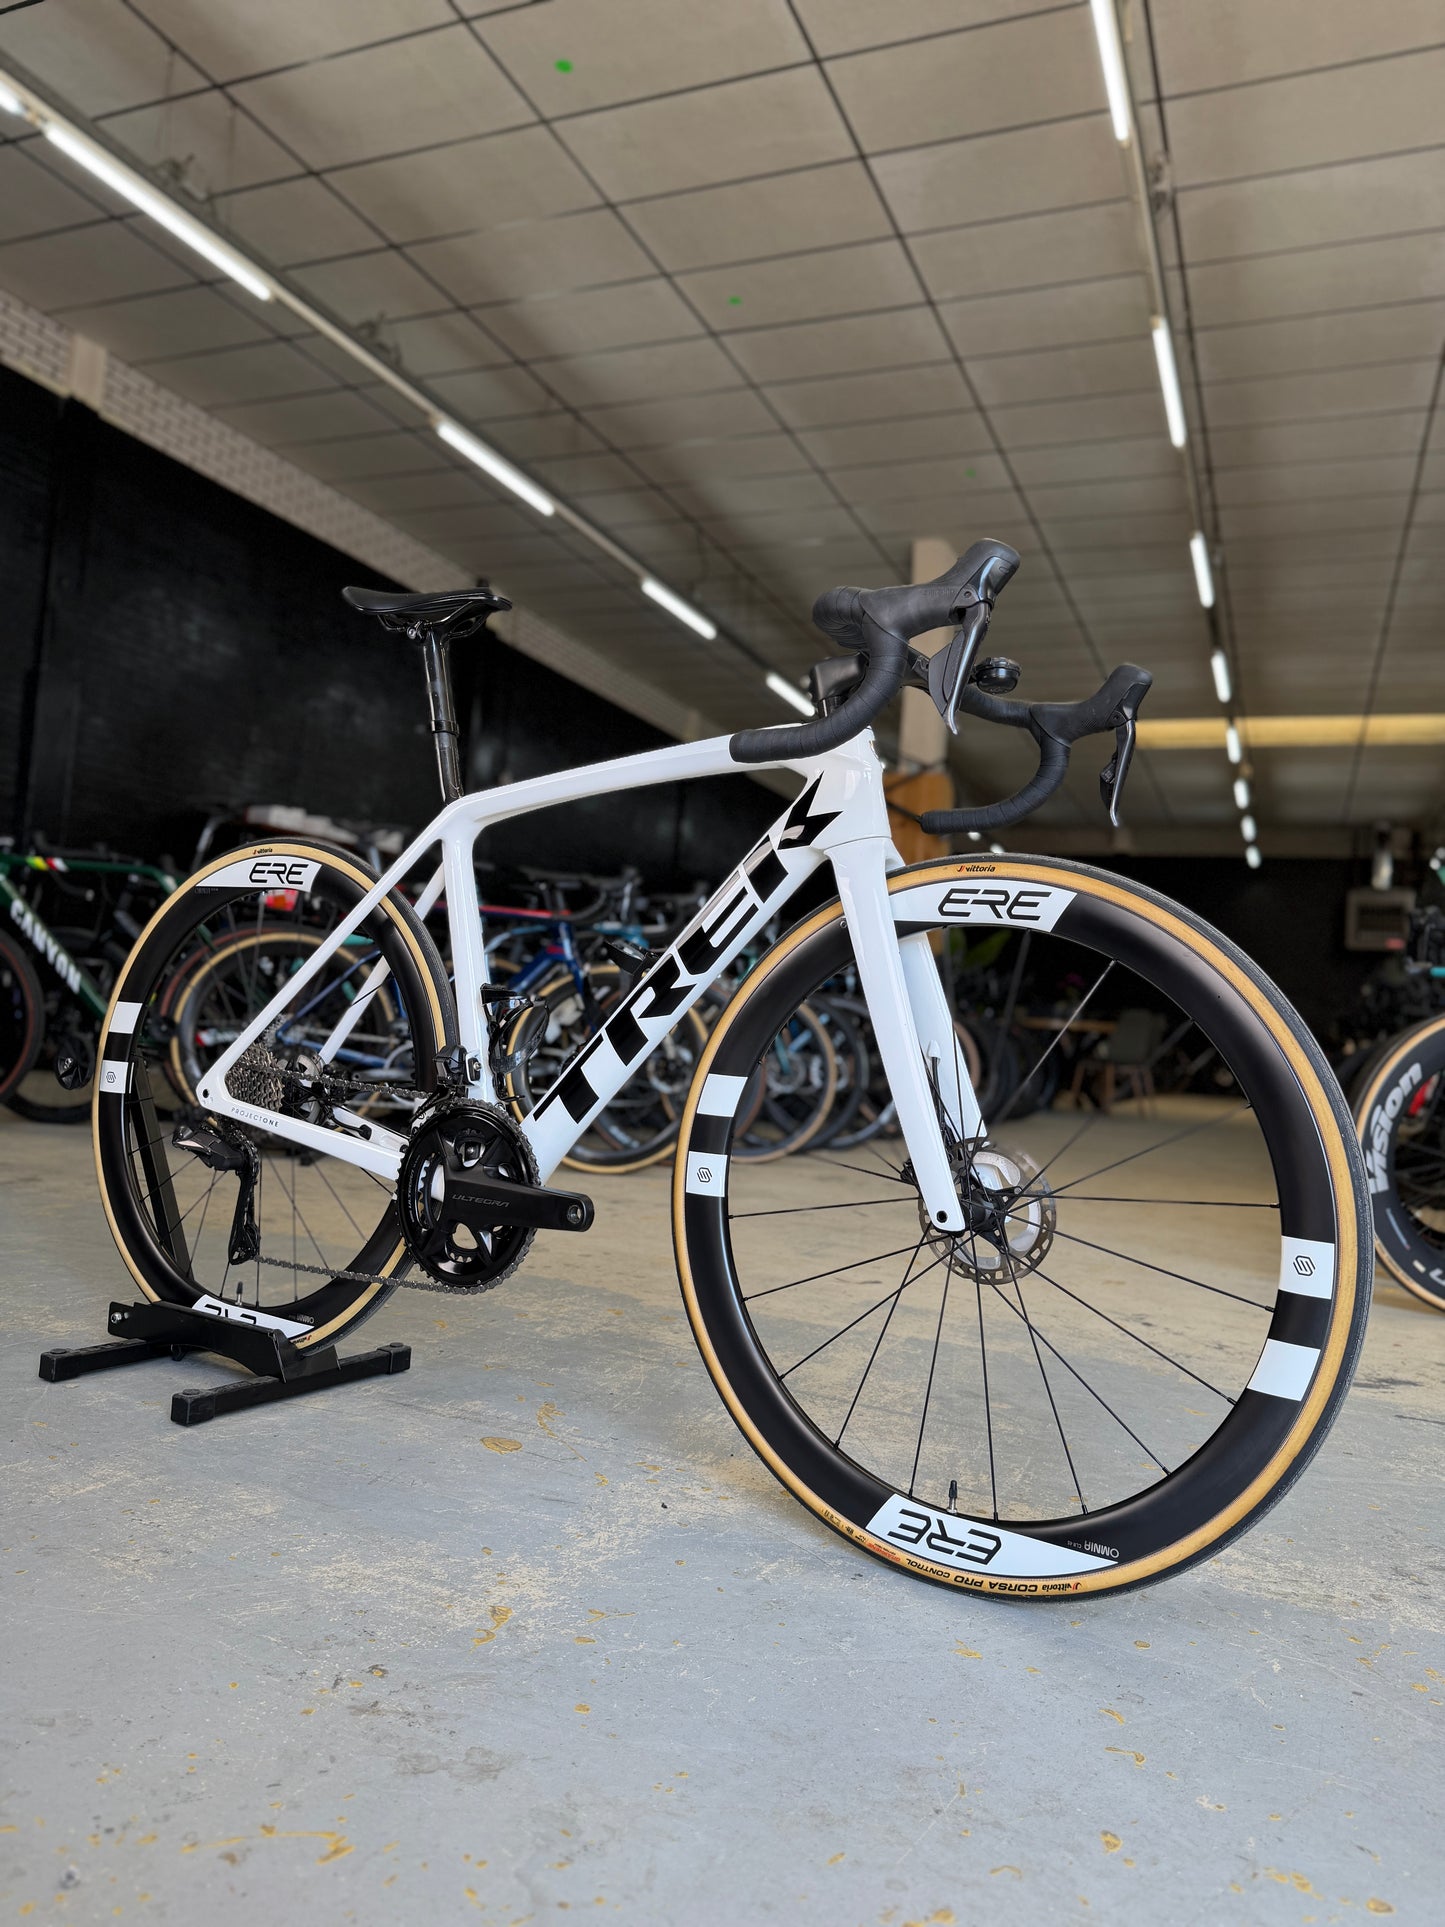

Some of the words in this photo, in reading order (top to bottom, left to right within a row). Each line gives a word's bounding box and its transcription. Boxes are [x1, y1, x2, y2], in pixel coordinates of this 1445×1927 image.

[249, 862, 309, 885] ERE
[965, 865, 996, 873] vittoria
[938, 888, 1052, 921] ERE
[10, 899, 82, 995] CANYON
[533, 770, 844, 1124] TREK
[452, 1194, 510, 1207] ULTEGRA
[887, 1508, 1002, 1566] ERE
[1084, 1540, 1120, 1558] OMNIA
[906, 1557, 951, 1579] CONTROL
[954, 1574, 984, 1588] PRO
[988, 1581, 1038, 1593] CORSA
[1041, 1581, 1072, 1593] vittoria
